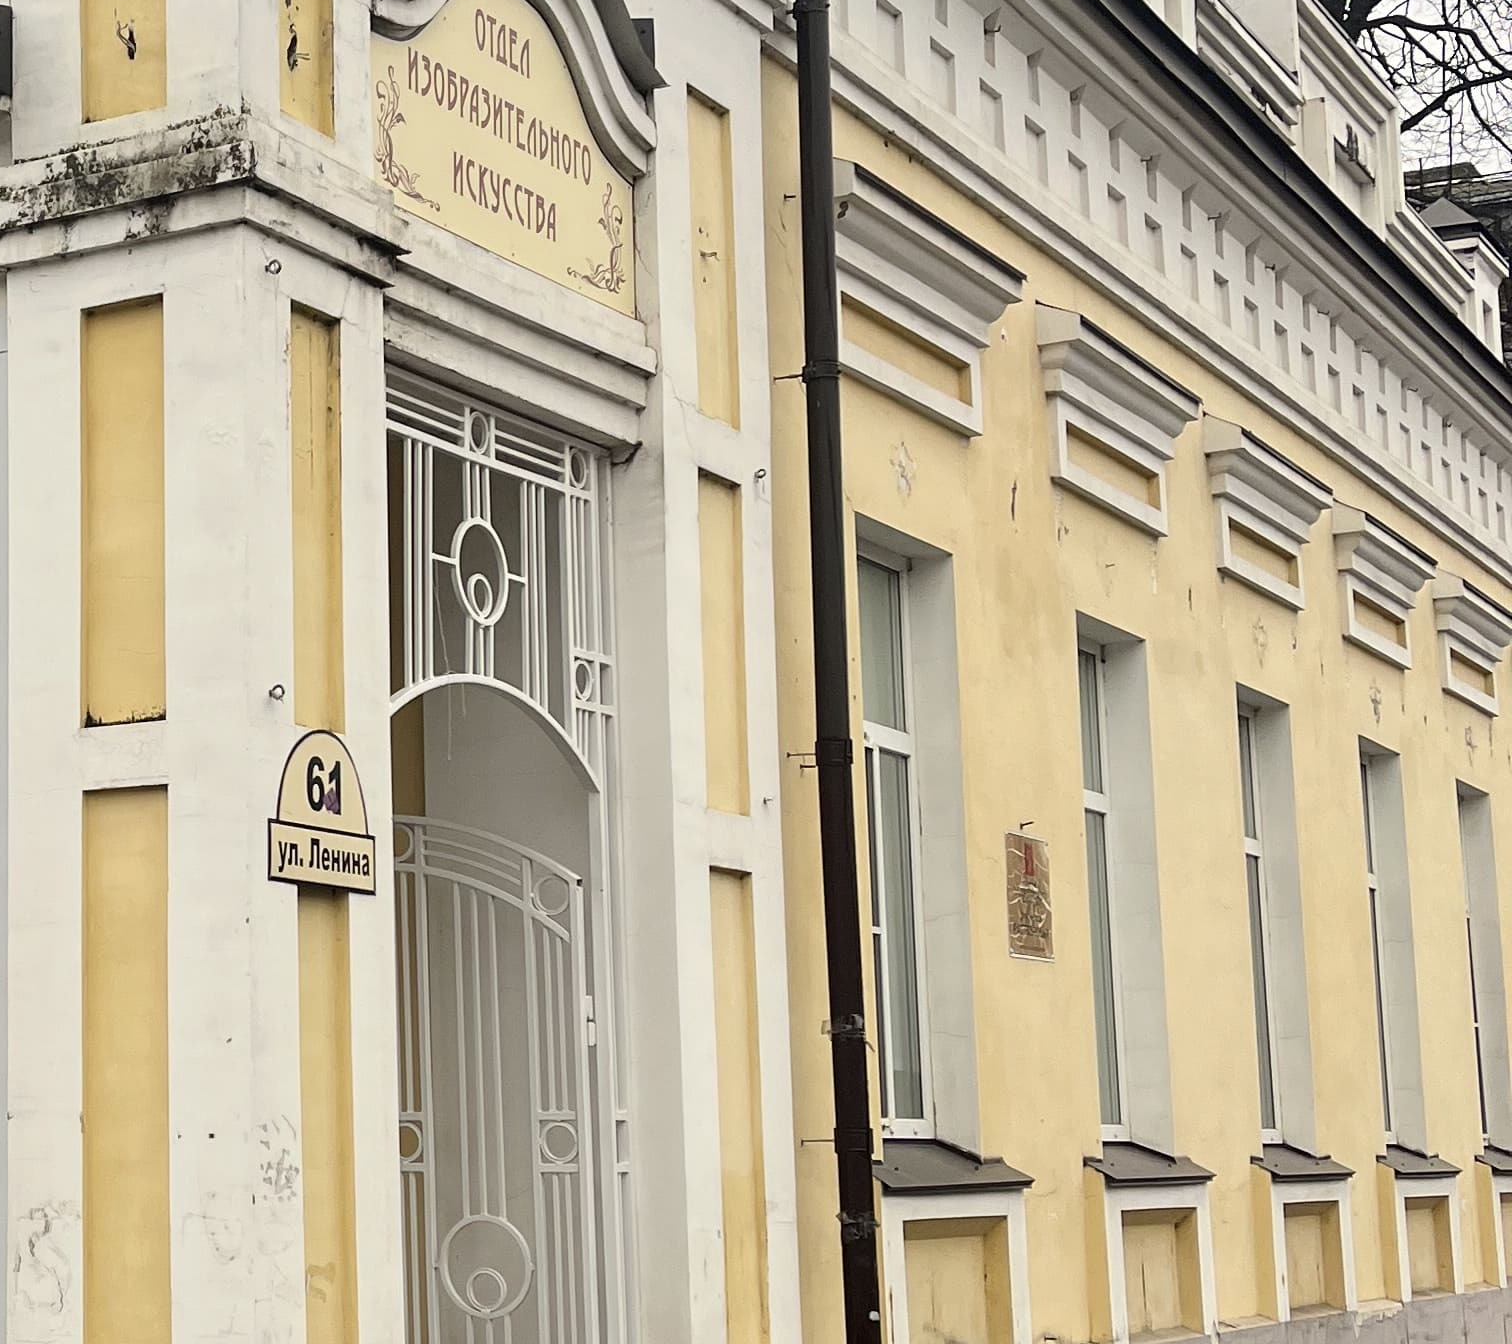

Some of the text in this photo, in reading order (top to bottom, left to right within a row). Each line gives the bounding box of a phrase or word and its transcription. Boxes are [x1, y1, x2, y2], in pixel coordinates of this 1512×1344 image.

[475, 9, 530, 79] ОТДЕЛ
[407, 46, 592, 186] ИЗОБРАЗИТЕЛЬНОГО
[452, 151, 557, 242] ИСКУССТВА
[307, 756, 341, 815] 61
[278, 838, 370, 876] ул. Ленина
